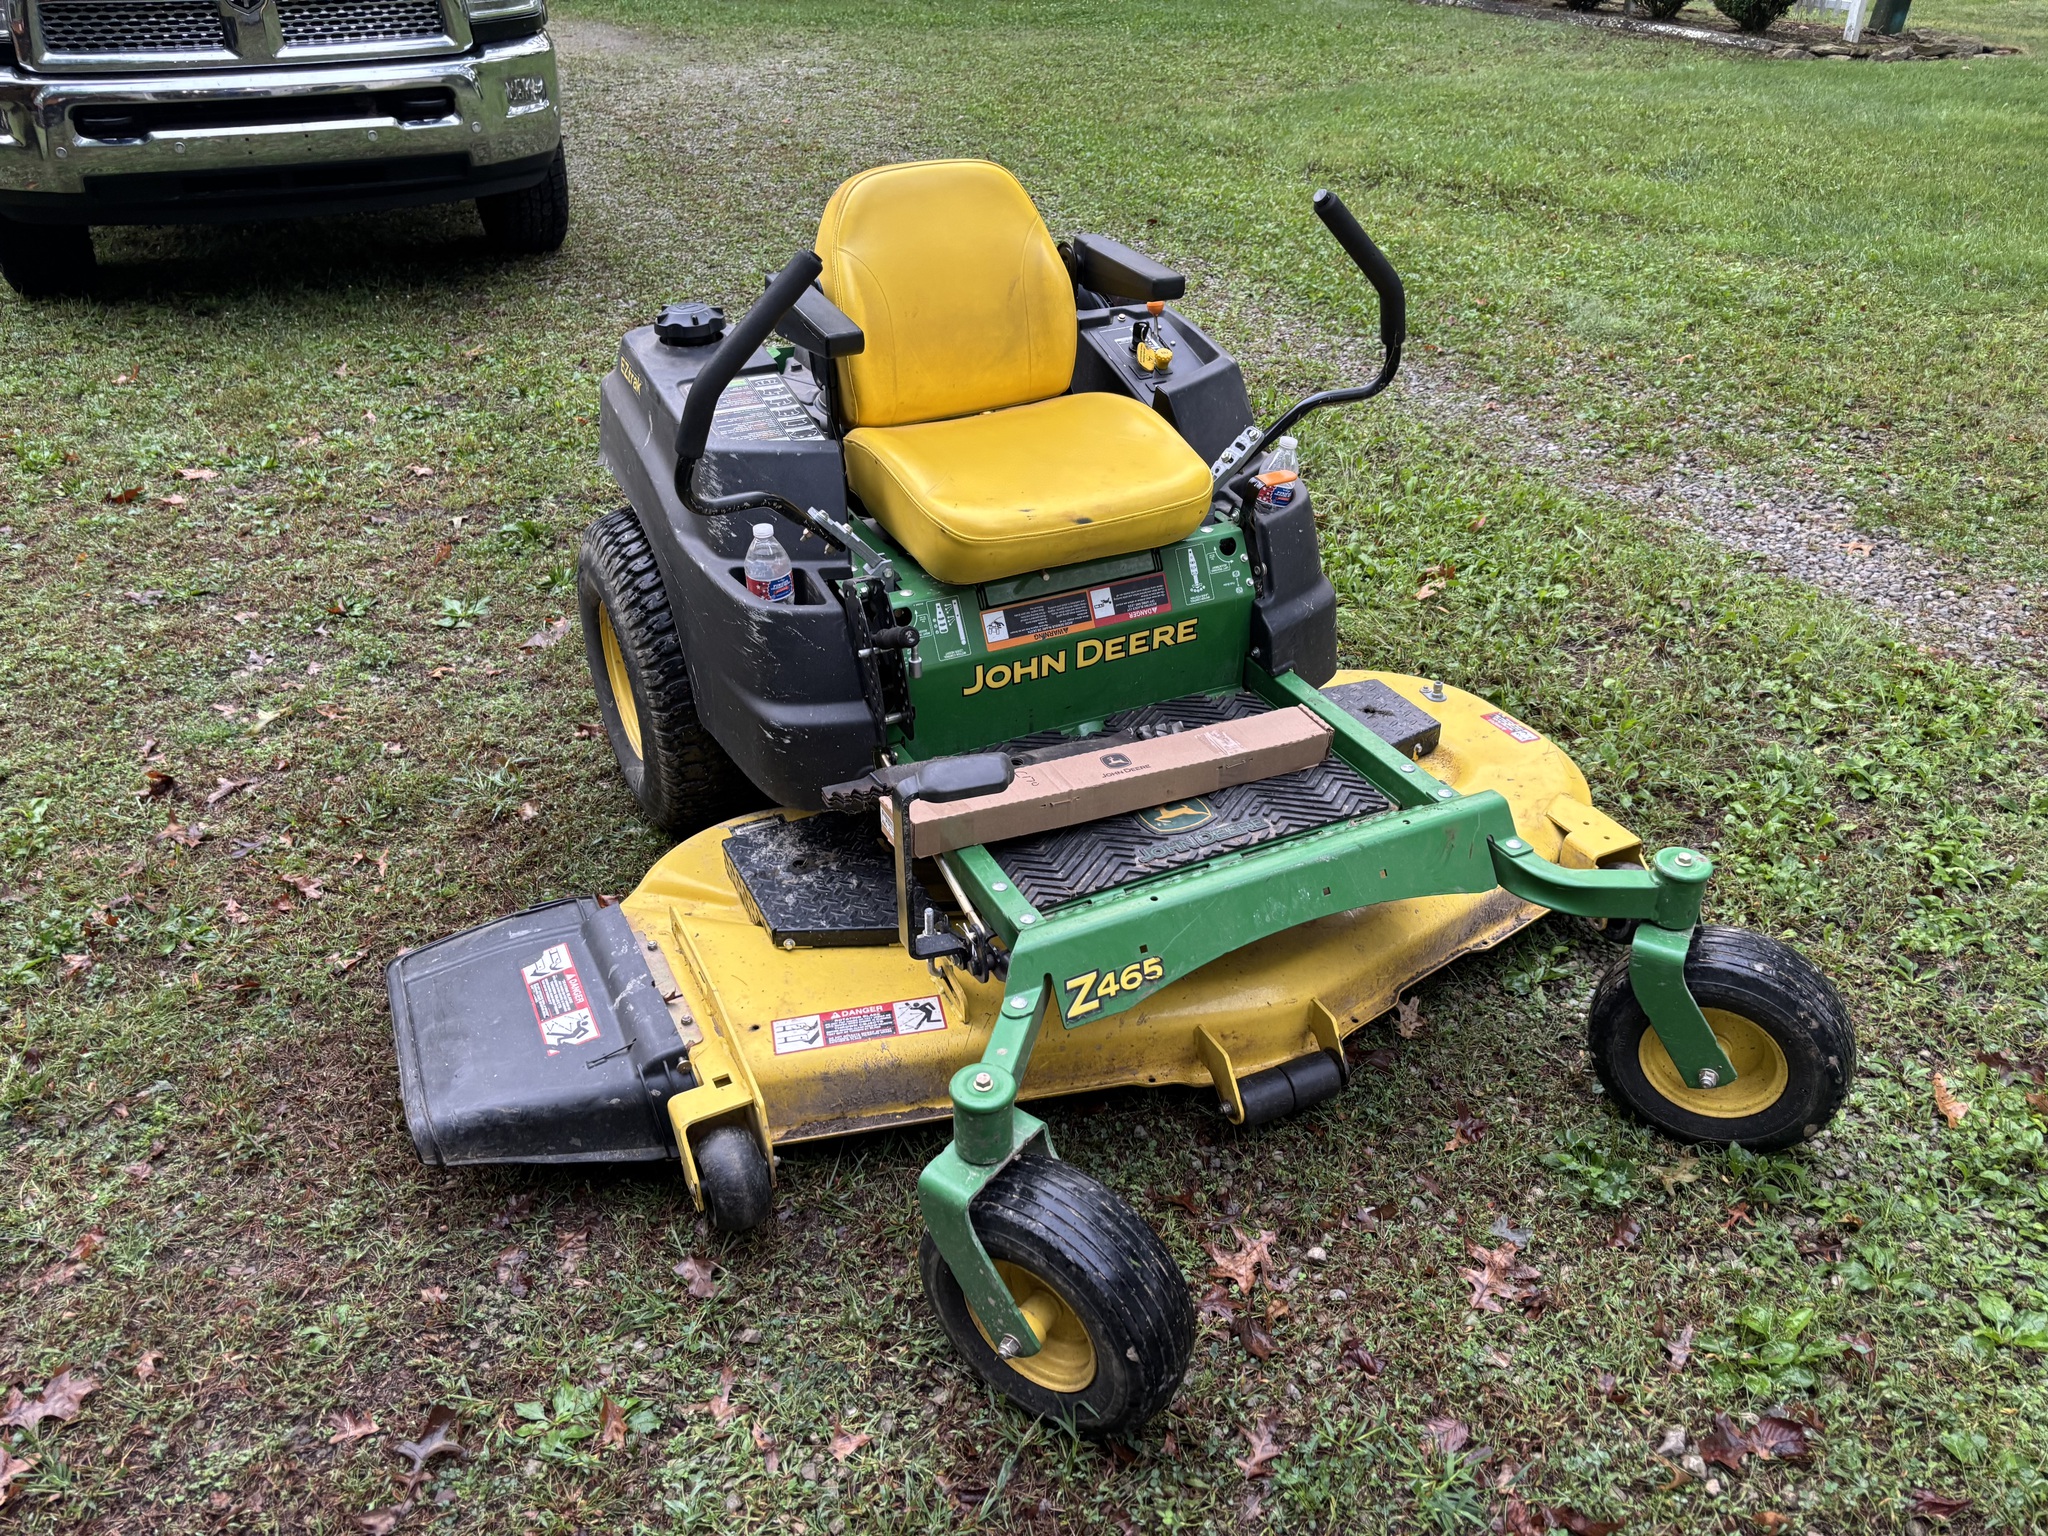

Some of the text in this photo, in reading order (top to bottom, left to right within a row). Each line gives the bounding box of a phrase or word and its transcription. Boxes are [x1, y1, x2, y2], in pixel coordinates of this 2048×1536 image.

[1129, 608, 1153, 619] DANGER
[1034, 628, 1064, 640] WARNING
[962, 650, 1066, 696] JOHN
[1076, 618, 1198, 669] DEERE
[1102, 764, 1151, 779] JOHN DEERE
[1137, 817, 1270, 863] JOHN DEERE
[568, 978, 585, 1004] DANGER
[1064, 957, 1164, 1020] Z465
[841, 1005, 883, 1018] DANGER
